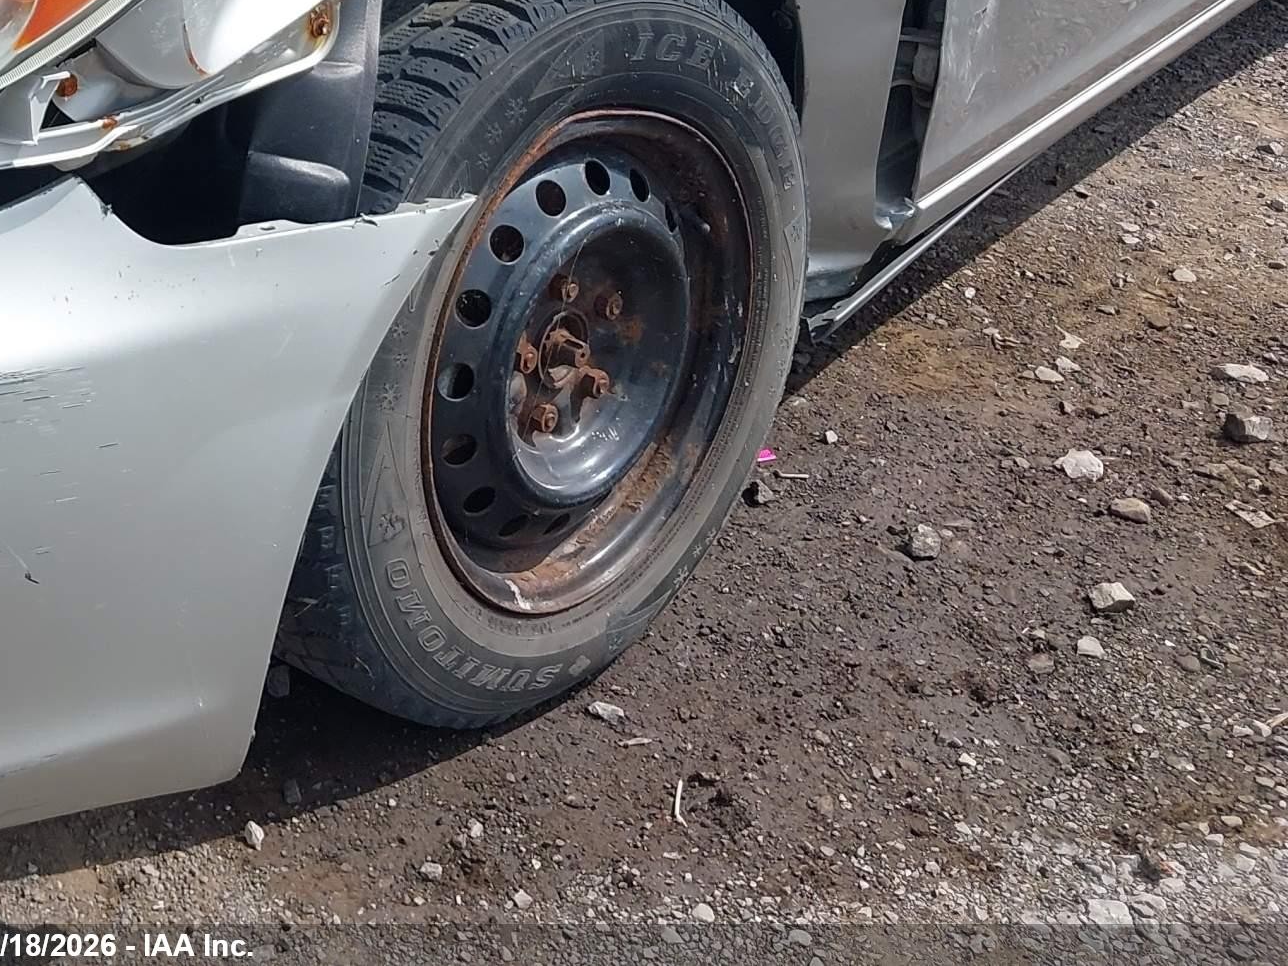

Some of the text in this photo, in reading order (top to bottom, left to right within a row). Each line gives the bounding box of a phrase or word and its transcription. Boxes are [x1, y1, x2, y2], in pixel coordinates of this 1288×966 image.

[630, 33, 795, 191] ICE EDGE
[385, 557, 563, 692] SUMITOMO
